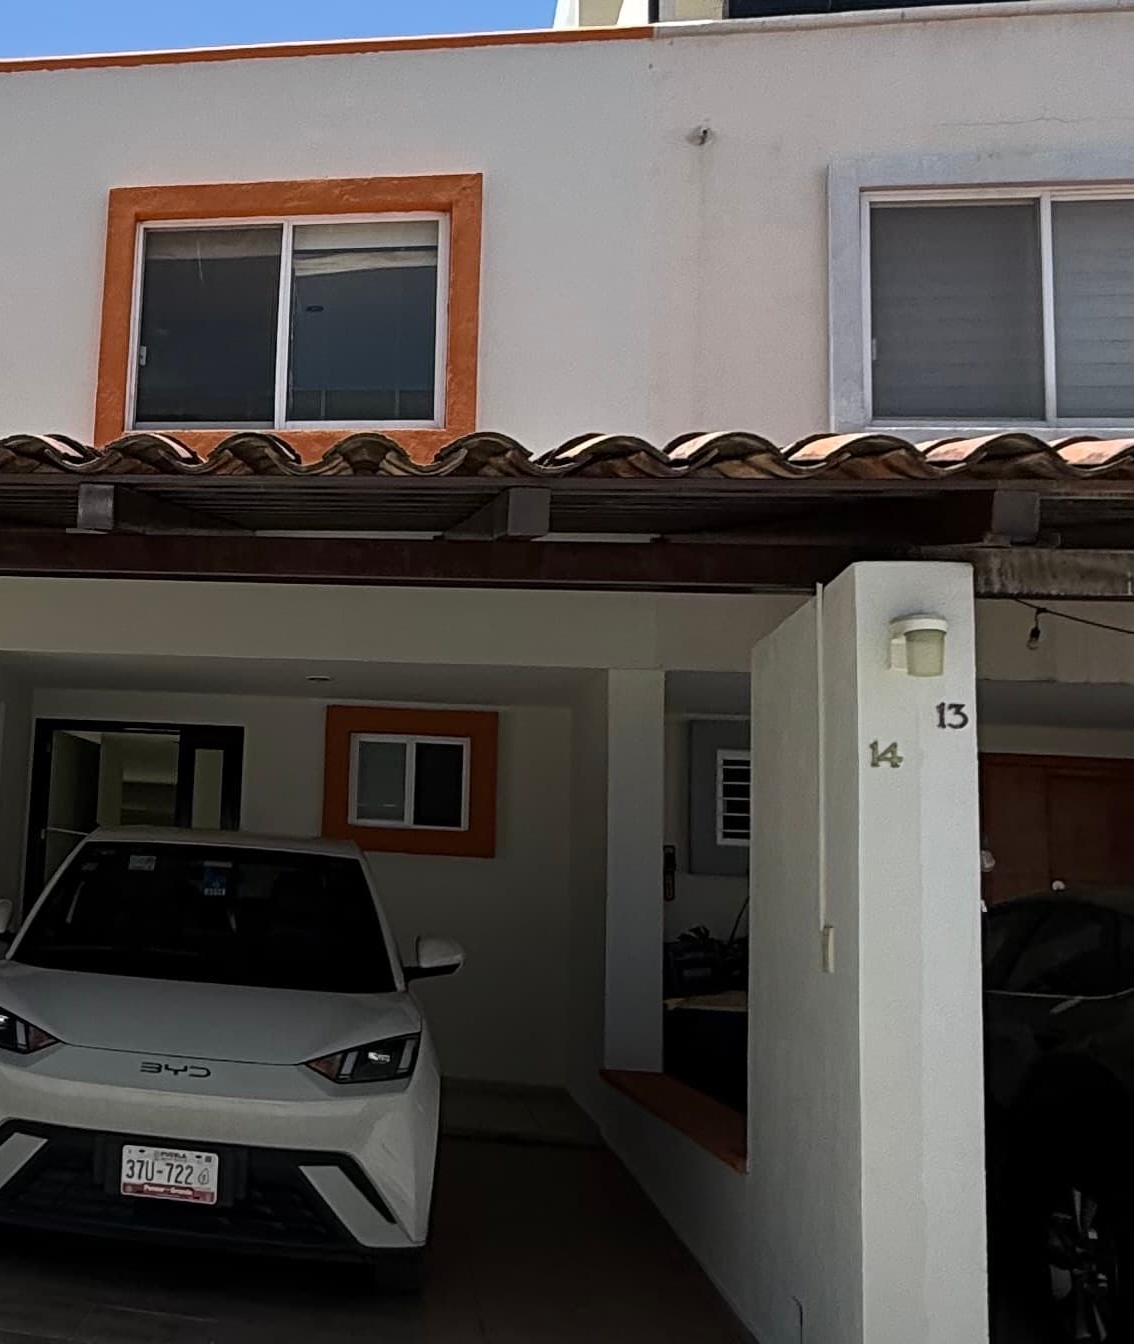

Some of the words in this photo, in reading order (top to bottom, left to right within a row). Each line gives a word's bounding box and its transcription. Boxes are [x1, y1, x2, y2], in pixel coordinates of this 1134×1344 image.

[935, 702, 969, 729] 13
[869, 740, 904, 768] 14
[139, 1061, 211, 1078] BYD
[125, 1159, 194, 1185] 37U-722
